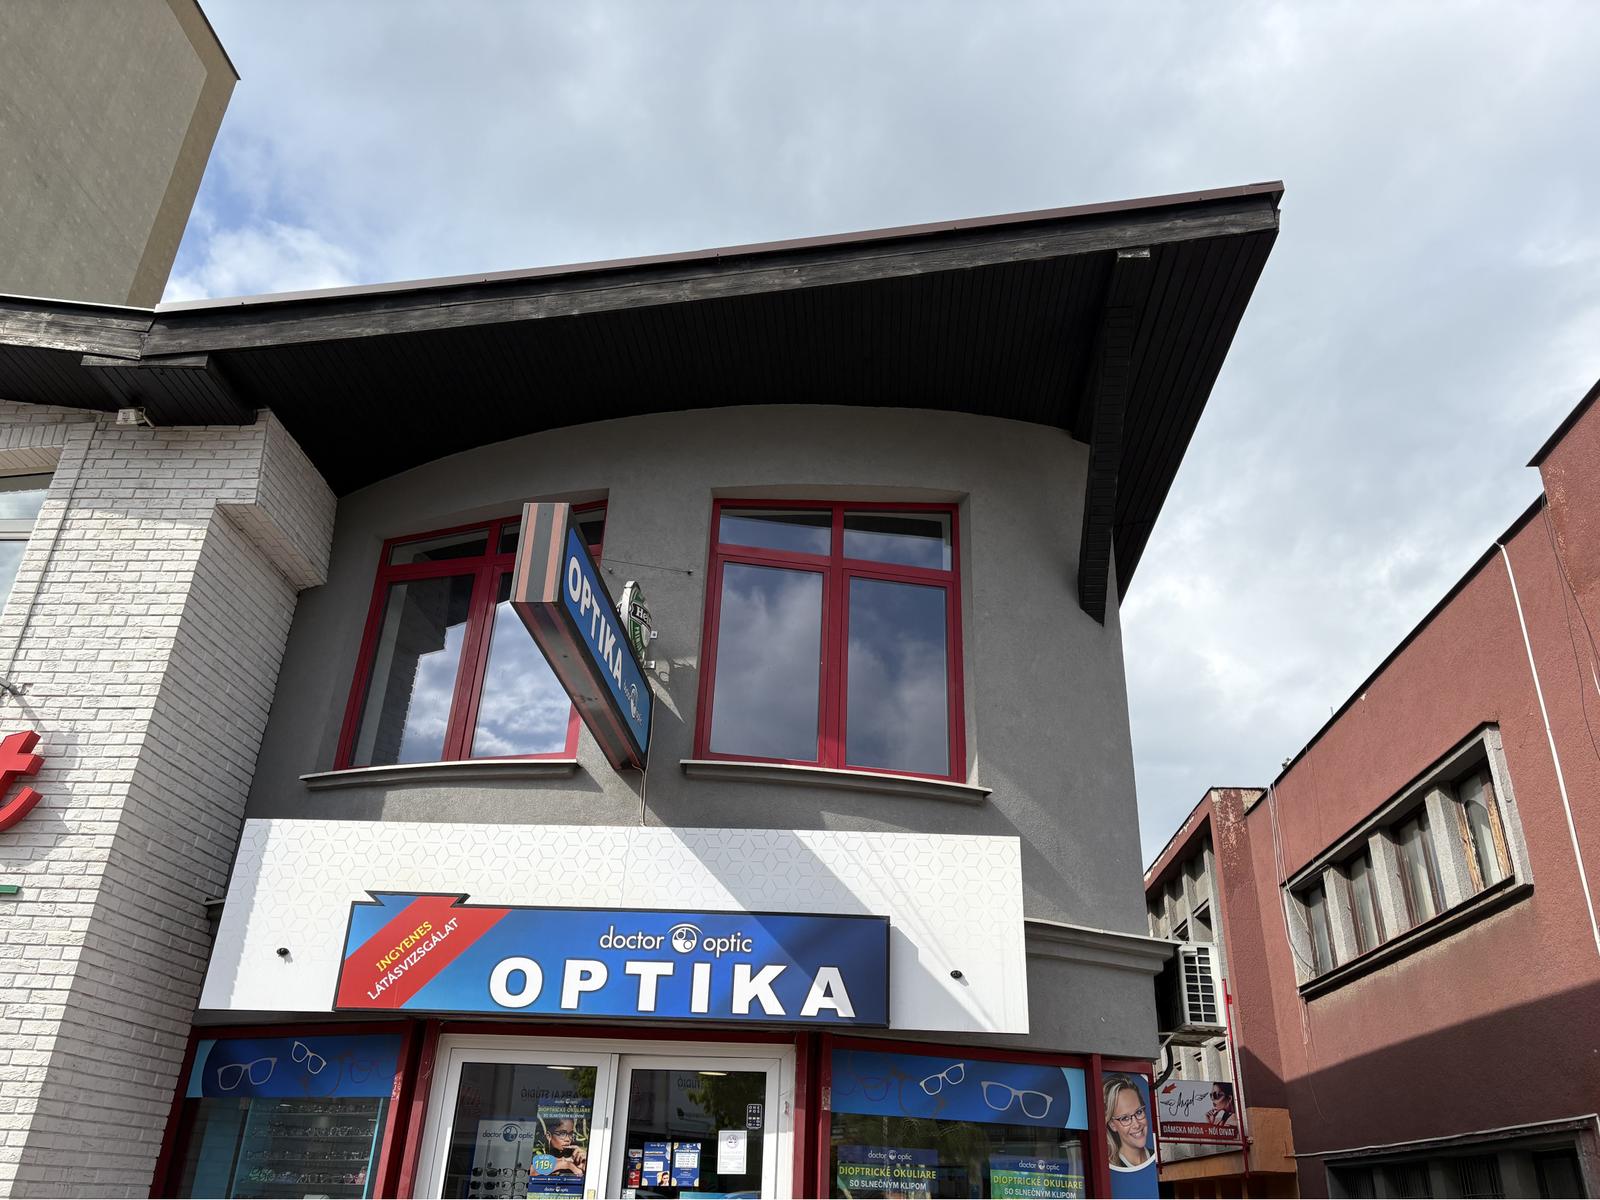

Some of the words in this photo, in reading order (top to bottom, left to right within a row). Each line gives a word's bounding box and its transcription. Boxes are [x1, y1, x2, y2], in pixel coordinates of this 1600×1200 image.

[568, 556, 622, 690] OPTIKA
[375, 920, 433, 973] INGYENES
[600, 926, 665, 951] doctor
[703, 933, 752, 958] optic
[367, 917, 460, 1000] LÁTÁSVIZSGÁLAT
[488, 956, 856, 1018] OPTIKA
[482, 1129, 502, 1138] doctor
[518, 1131, 534, 1140] optic
[1163, 1124, 1187, 1133] DÁMSKA
[1188, 1126, 1204, 1135] MÓDA
[868, 1150, 887, 1159] doctor
[897, 1153, 913, 1161] optic
[839, 1165, 891, 1177] DIOPTRICKÉ
[893, 1168, 937, 1180] OKULIARE
[1019, 1160, 1037, 1169] doctor
[1046, 1163, 1061, 1172] optic
[860, 1179, 900, 1189] SLNEČNÝM
[900, 1182, 927, 1191] KLIPOM
[993, 1174, 1041, 1187] DIOPTRICKÉ
[1043, 1178, 1083, 1190] OKULIARE
[1004, 1187, 1014, 1195] SO
[1014, 1187, 1051, 1198] SLNEČNÝM
[1051, 1191, 1077, 1199] KLIPOM
